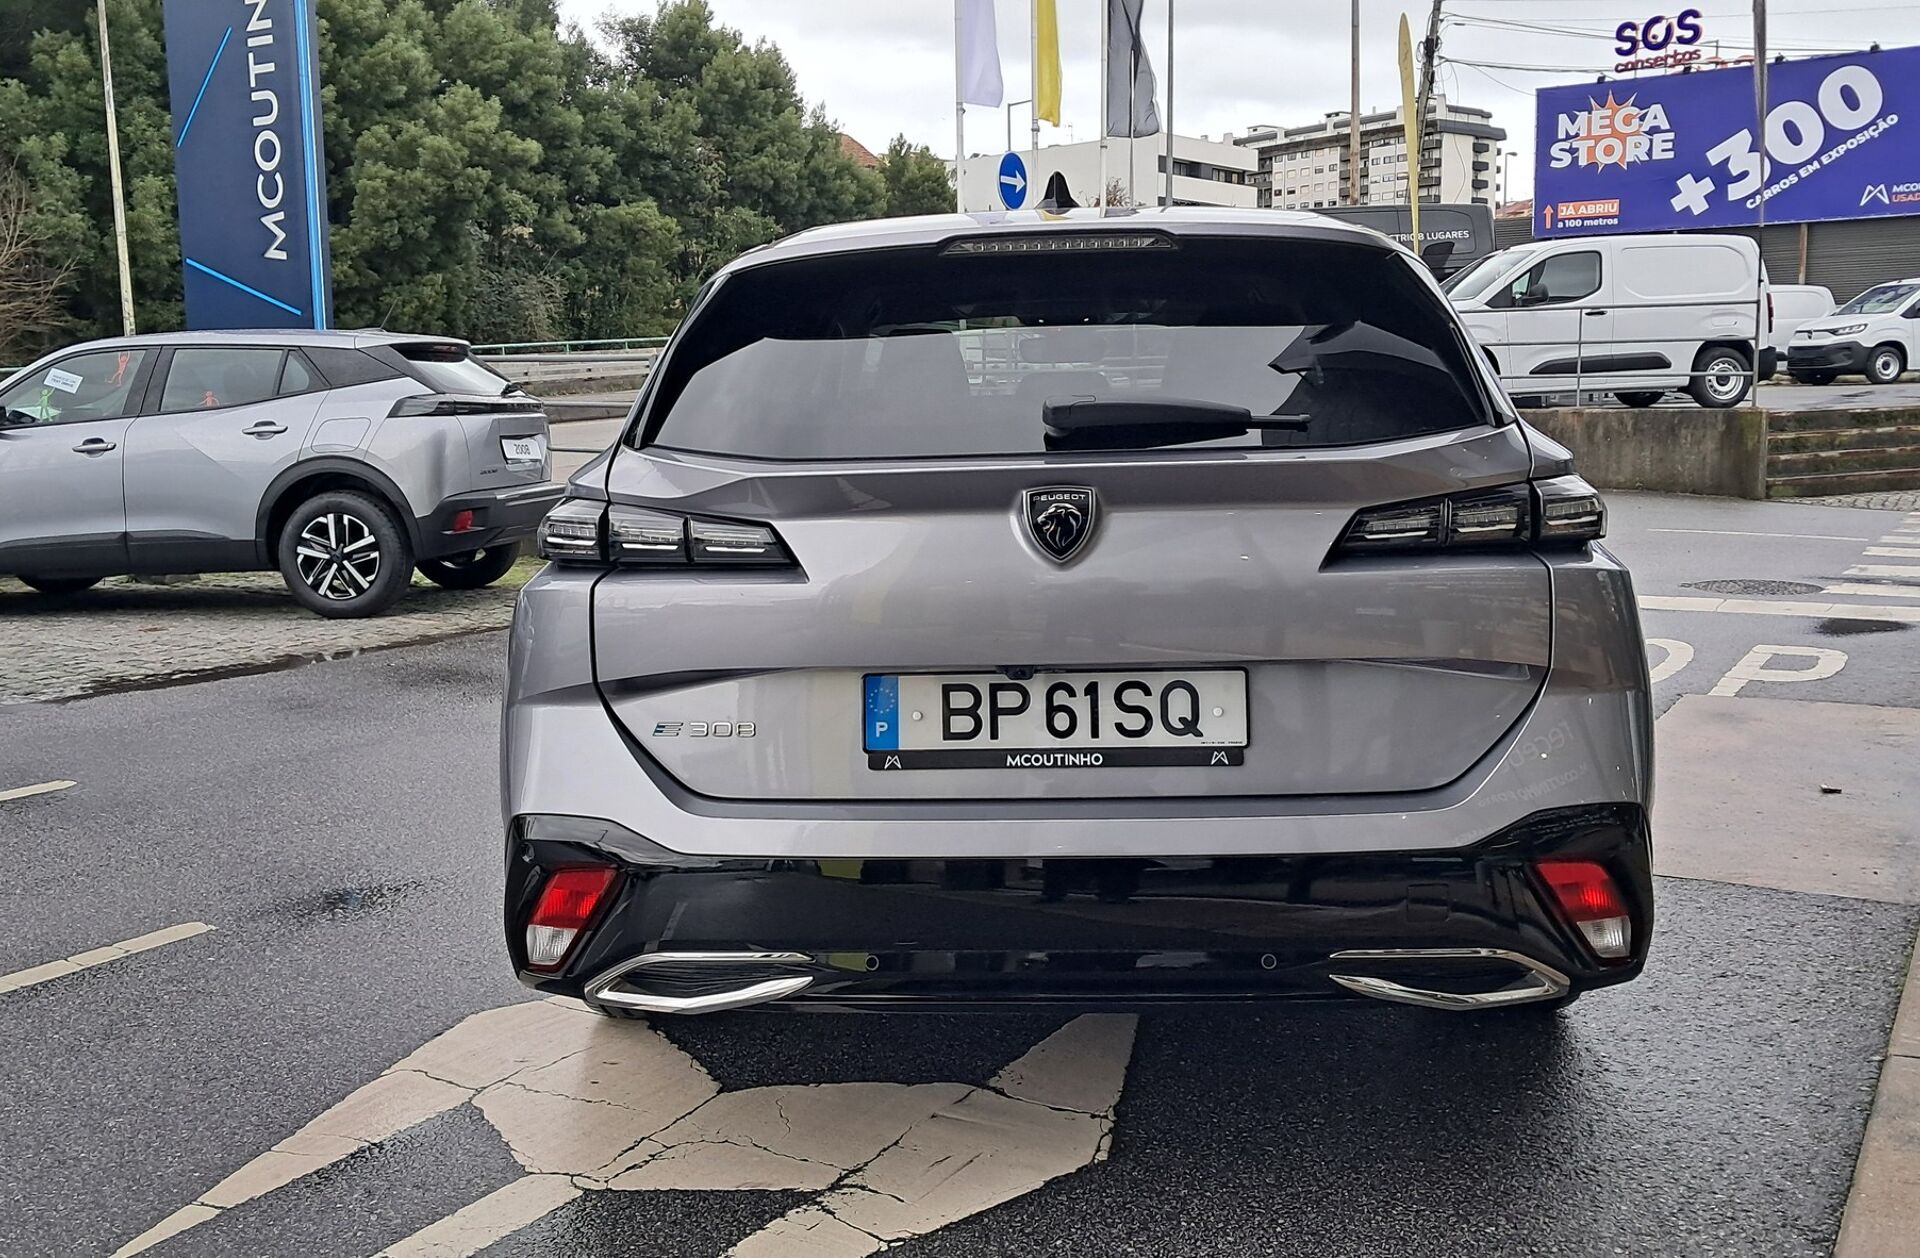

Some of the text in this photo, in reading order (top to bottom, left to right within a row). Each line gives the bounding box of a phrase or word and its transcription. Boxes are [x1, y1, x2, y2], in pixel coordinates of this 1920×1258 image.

[1615, 9, 1702, 57] SOS
[1615, 49, 1701, 73] consertos
[1558, 104, 1671, 139] MEGA
[1550, 132, 1675, 168] STORE
[1746, 113, 1899, 209] CARROS EM EXPOSIÇÃO
[1892, 183, 1920, 193] MCO
[1560, 203, 1617, 216] JÁ ABRIU
[1565, 219, 1582, 227] 100
[1584, 217, 1618, 226] metros
[1427, 230, 1469, 240] LUGARES
[1033, 493, 1086, 501] PEUGEOT
[941, 679, 1204, 741] BP 61 SQ
[689, 721, 757, 738] 308
[875, 722, 887, 737] P
[1006, 753, 1103, 767] MCOUTINHO
